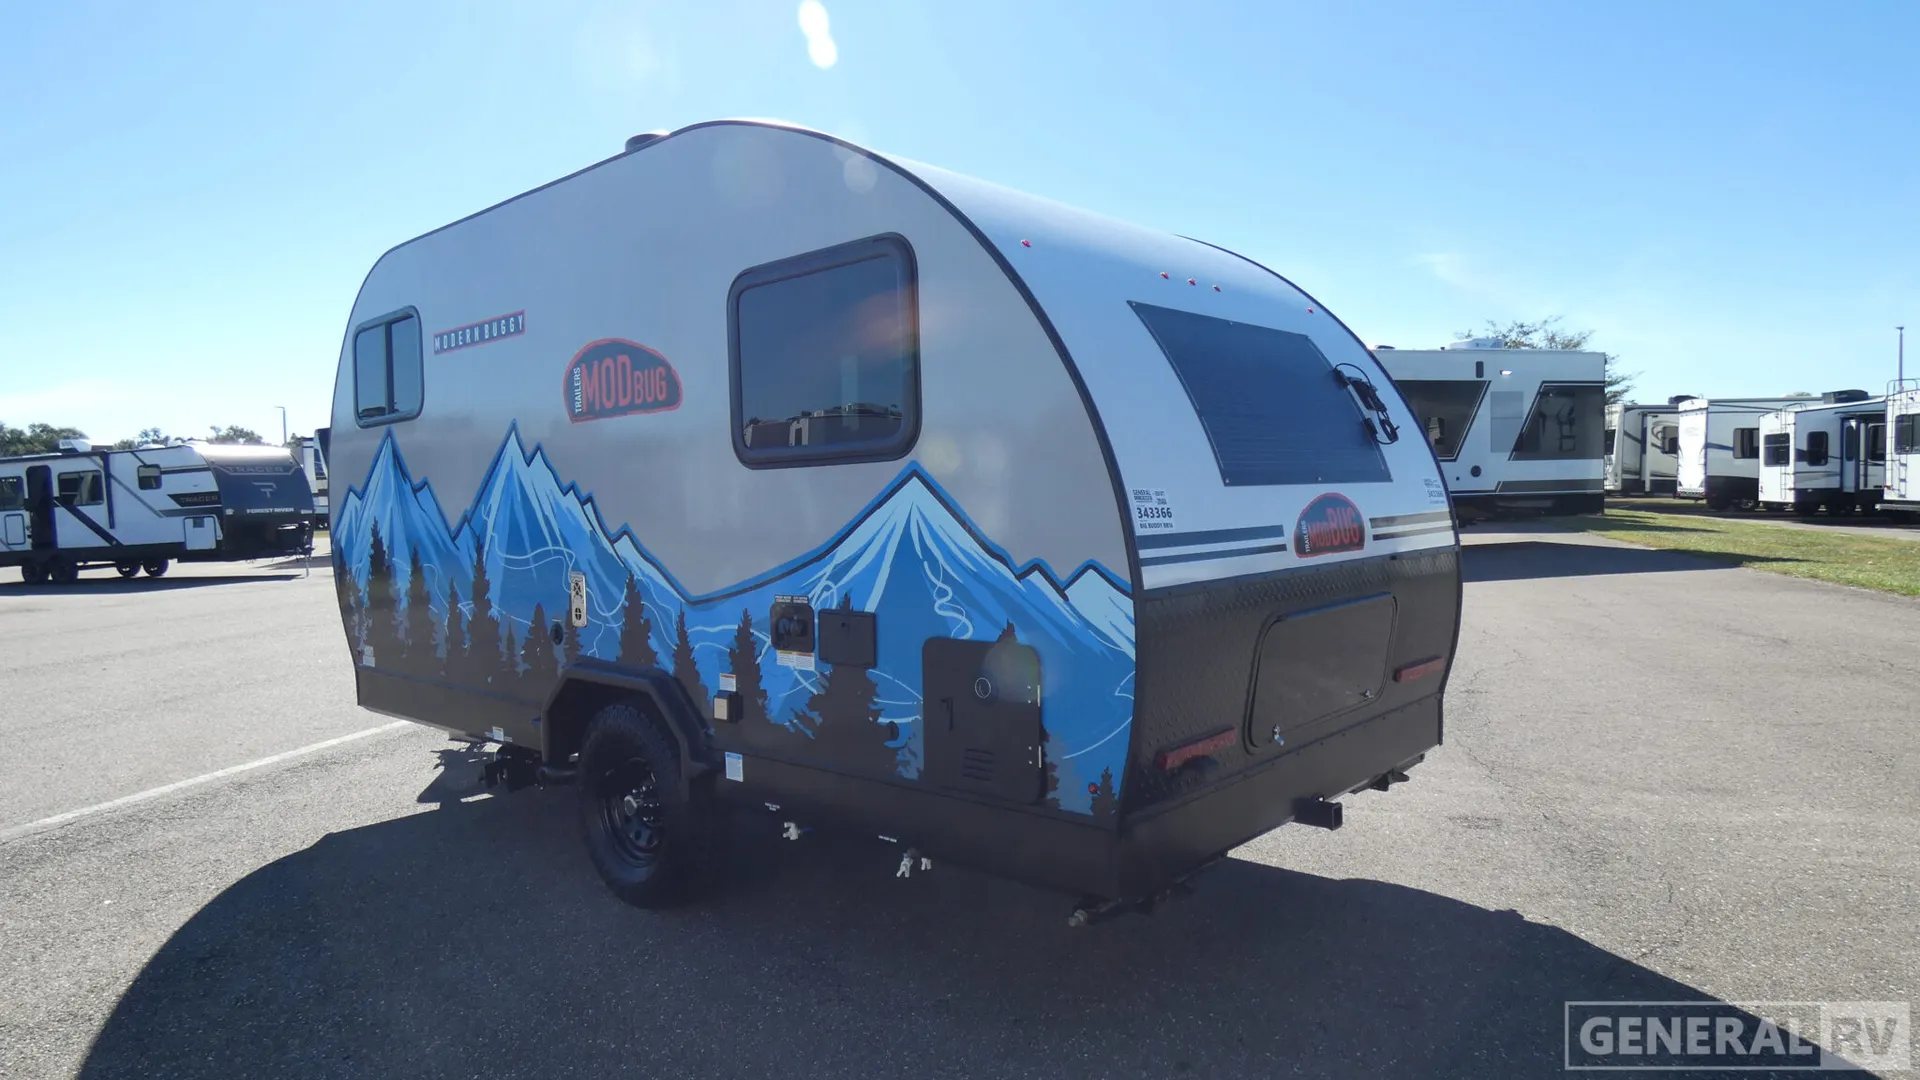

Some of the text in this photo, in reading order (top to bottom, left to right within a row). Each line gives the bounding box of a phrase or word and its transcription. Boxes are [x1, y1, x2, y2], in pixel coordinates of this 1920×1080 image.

[434, 314, 524, 351] MODERN BUGGY
[574, 367, 582, 413] TRAILERS
[226, 465, 284, 473] TRACER
[1136, 507, 1173, 519] 343366
